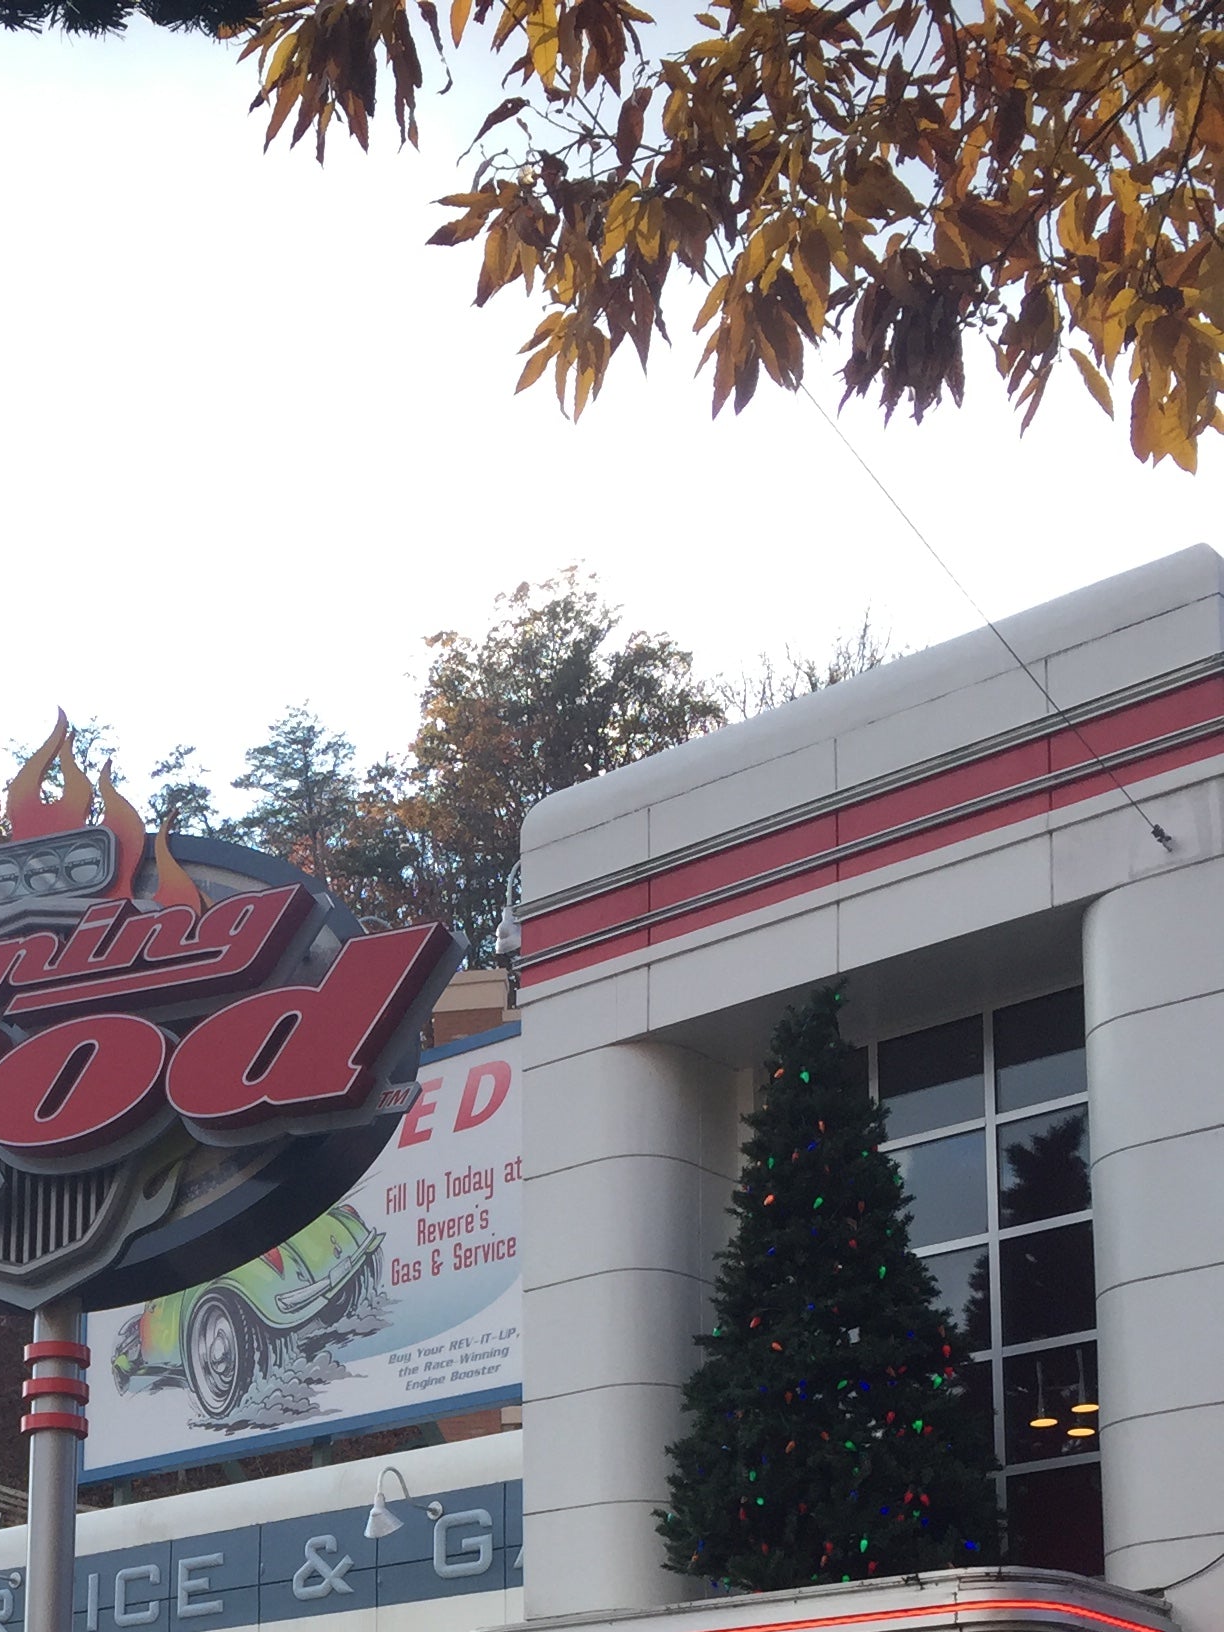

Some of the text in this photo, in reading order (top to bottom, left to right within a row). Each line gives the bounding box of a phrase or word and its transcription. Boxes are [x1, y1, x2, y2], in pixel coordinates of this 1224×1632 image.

[377, 1087, 410, 1109] TM
[397, 1060, 512, 1150] ED
[385, 1155, 523, 1216] Fill Up Today at
[416, 1203, 489, 1247] Revere's
[391, 1232, 517, 1287] Gas & Service
[387, 1352, 412, 1365] Buy
[416, 1345, 445, 1359] Your
[398, 1365, 419, 1378] the
[405, 1363, 502, 1391] Engine Booster
[292, 1534, 355, 1600] &
[433, 1508, 523, 1580] G
